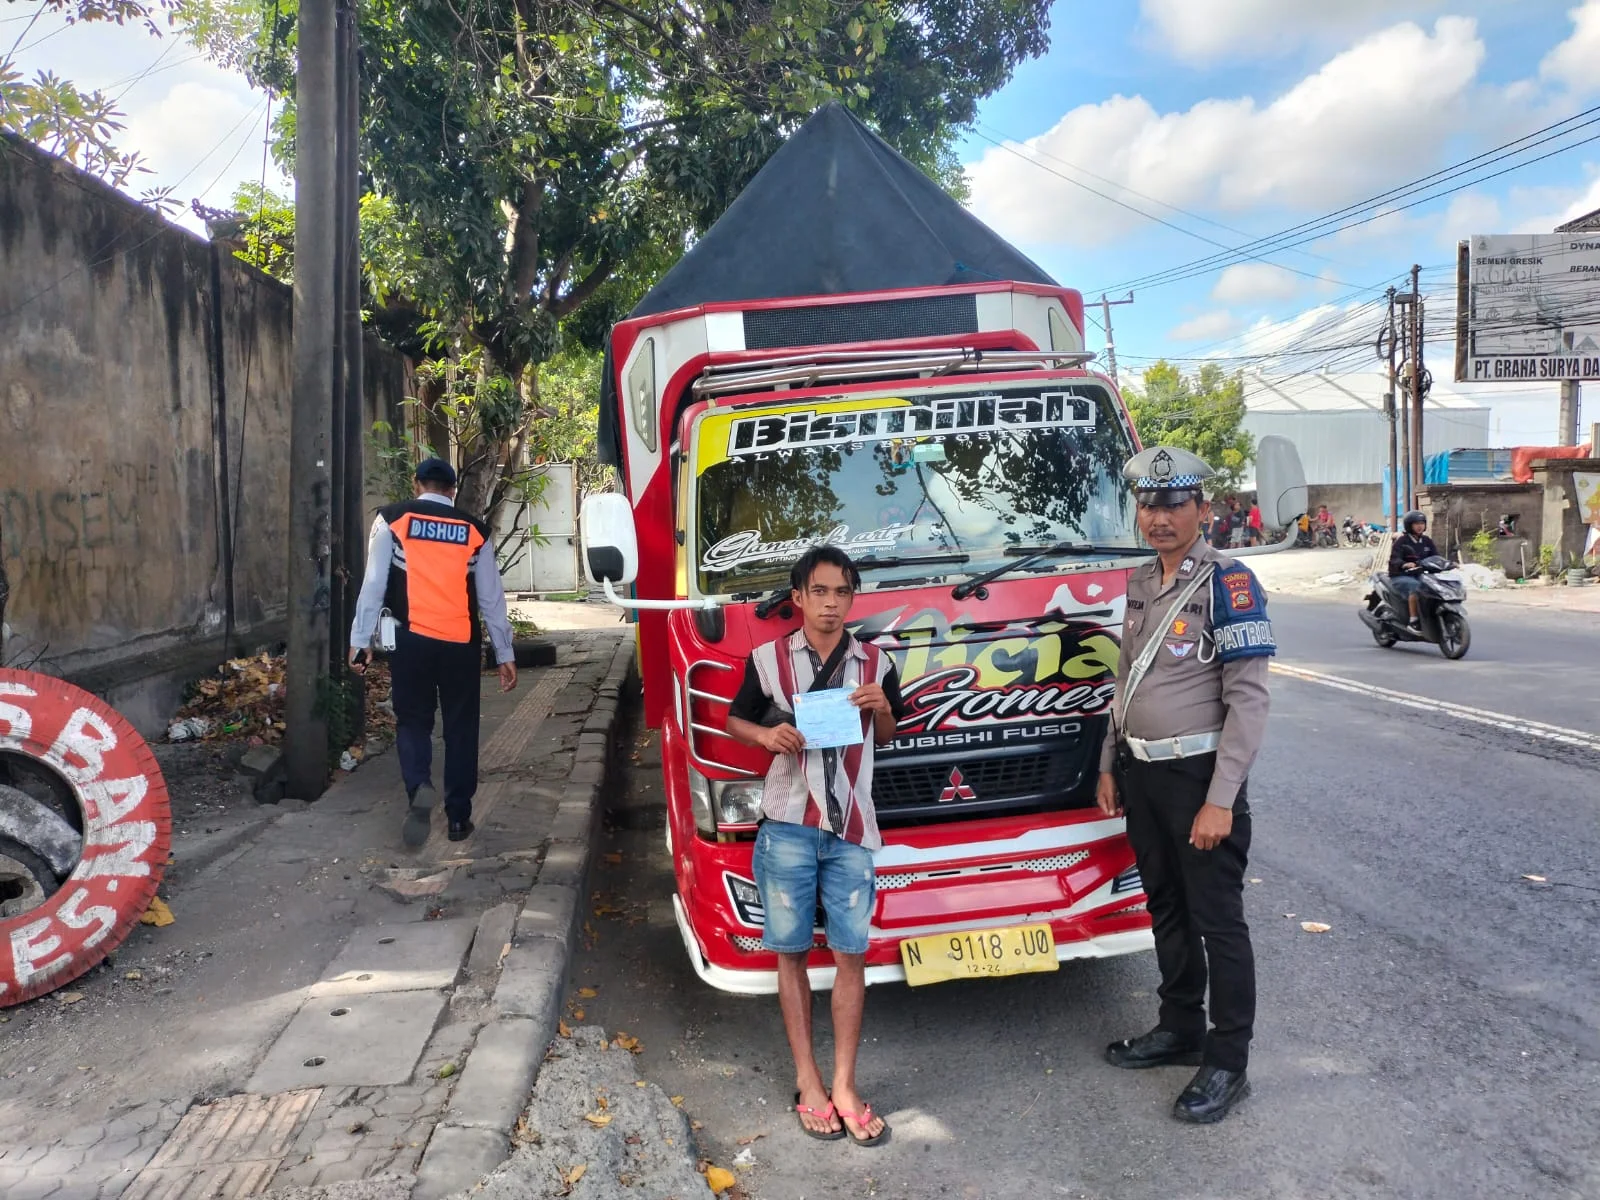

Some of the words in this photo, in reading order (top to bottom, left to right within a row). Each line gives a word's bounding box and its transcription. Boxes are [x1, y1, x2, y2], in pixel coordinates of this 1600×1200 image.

[1476, 257, 1507, 265] SEMEN
[1509, 256, 1543, 265] GRESIK
[1475, 360, 1491, 379] PT.
[1494, 359, 1537, 378] GRAHA
[1540, 358, 1580, 377] SURYA
[731, 441, 865, 464] ALWAYS
[881, 437, 917, 448] BE
[934, 426, 1097, 444] POSITIVE
[410, 519, 468, 543] DISHUB
[896, 667, 1117, 731] Gomes
[876, 731, 993, 752] SUBISHI
[1002, 722, 1082, 741] FUSO
[906, 941, 923, 967] N
[949, 934, 1004, 961] 9118
